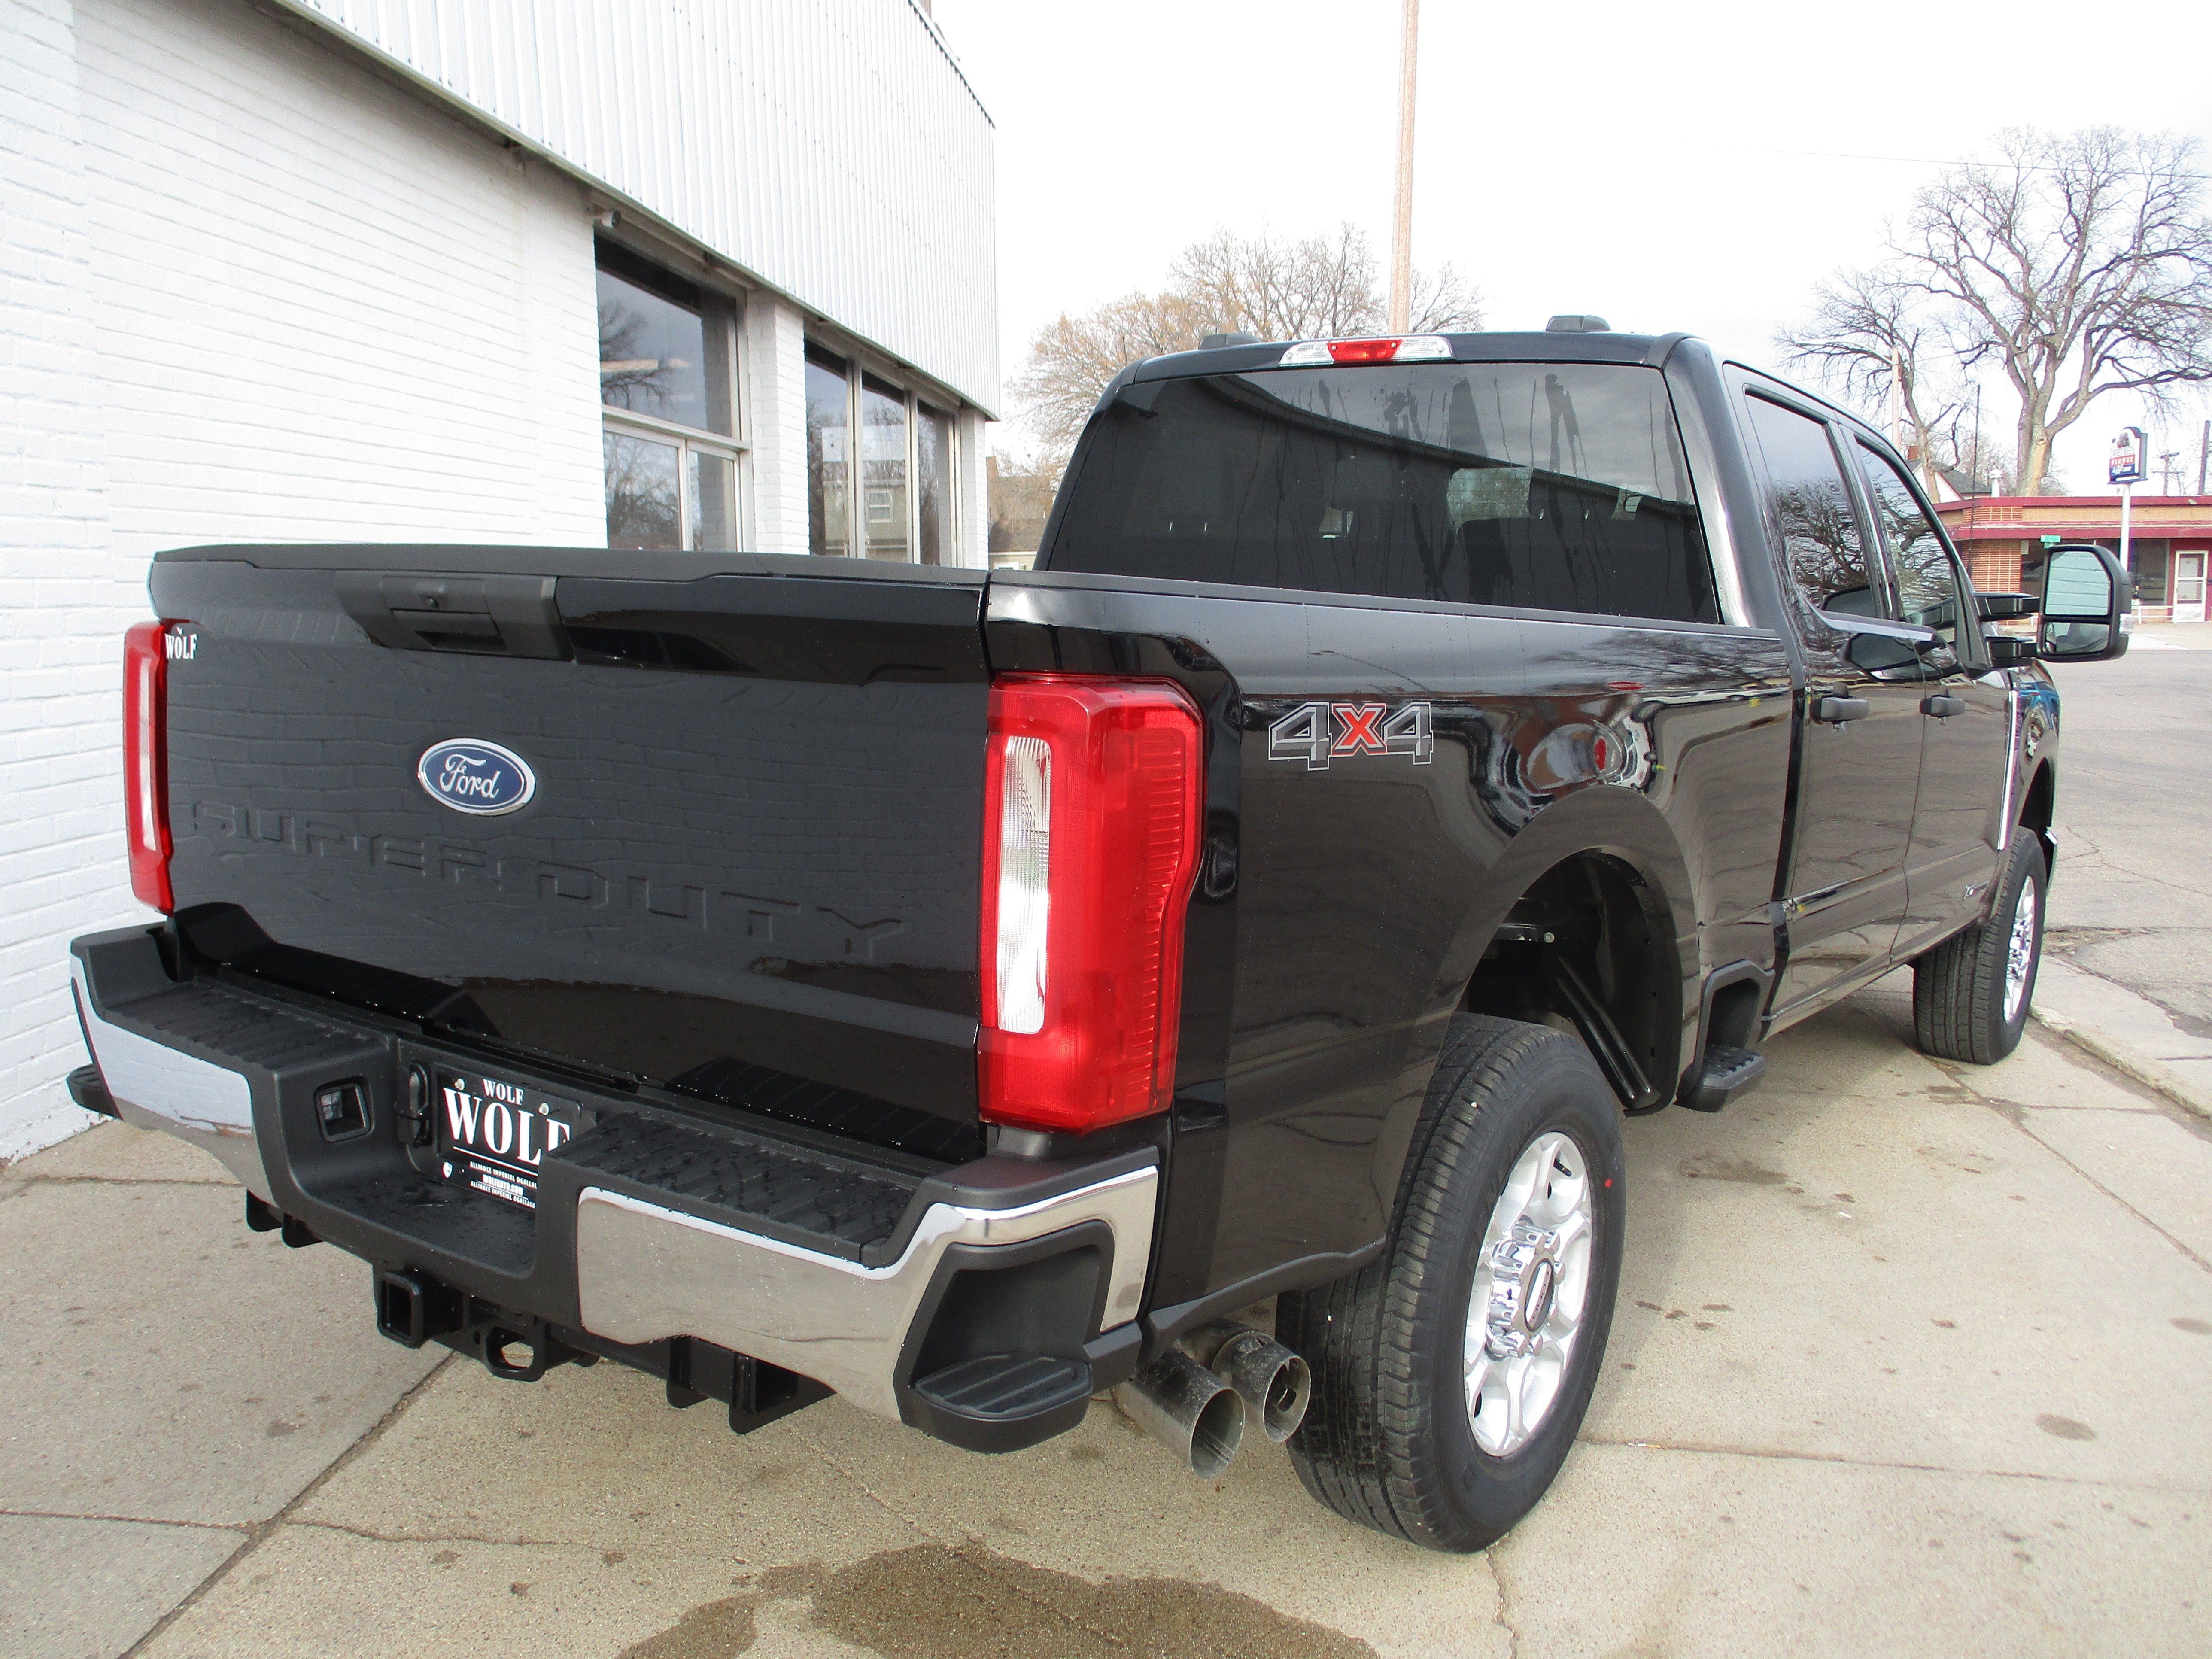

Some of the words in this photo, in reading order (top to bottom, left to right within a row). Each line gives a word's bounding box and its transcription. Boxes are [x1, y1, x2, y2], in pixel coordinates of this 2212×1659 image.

[165, 633, 198, 659] WOLF
[439, 754, 501, 799] Ford
[193, 800, 503, 891] SUPER
[538, 860, 903, 961] DUTY
[482, 1078, 524, 1106] WOLF
[469, 1161, 492, 1174] ALLIANCE
[493, 1168, 515, 1182] IMPERIAL
[516, 1176, 538, 1190] OGALLAL
[482, 1173, 524, 1196] WOLFAUTO.COM
[470, 1180, 491, 1193] ALLIANCE
[492, 1188, 512, 1200] IMPERIAL
